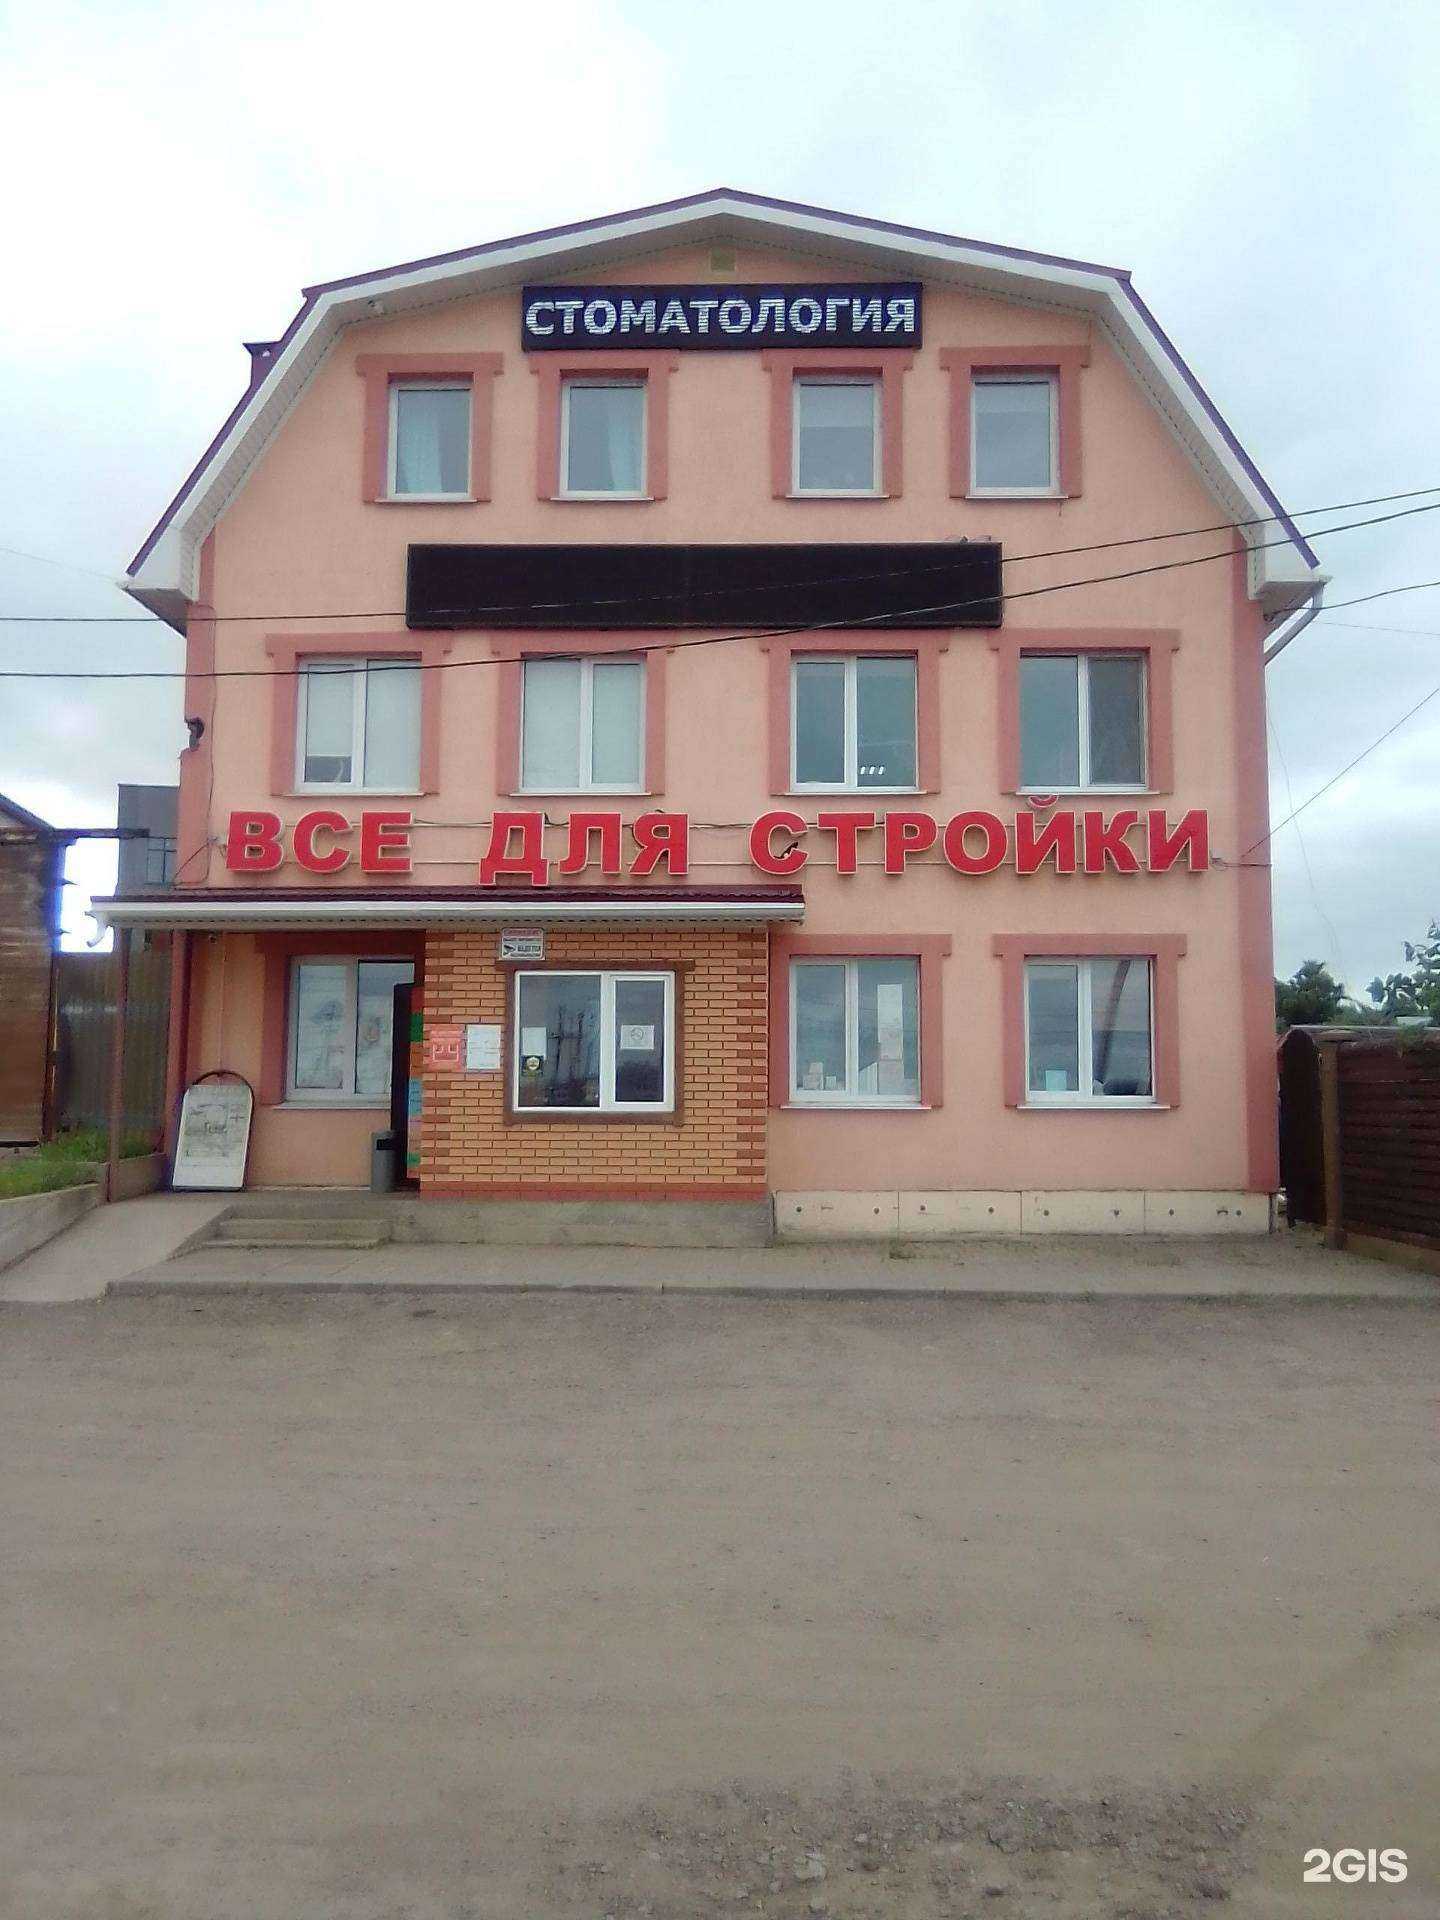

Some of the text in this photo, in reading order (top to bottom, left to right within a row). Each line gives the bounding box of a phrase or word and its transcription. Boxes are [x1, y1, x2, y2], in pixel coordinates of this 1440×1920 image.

[525, 298, 915, 335] СТОМАТОЛОГИЯ
[226, 795, 1210, 887] ВСЕ ДЛЯ СТРОЙКИ
